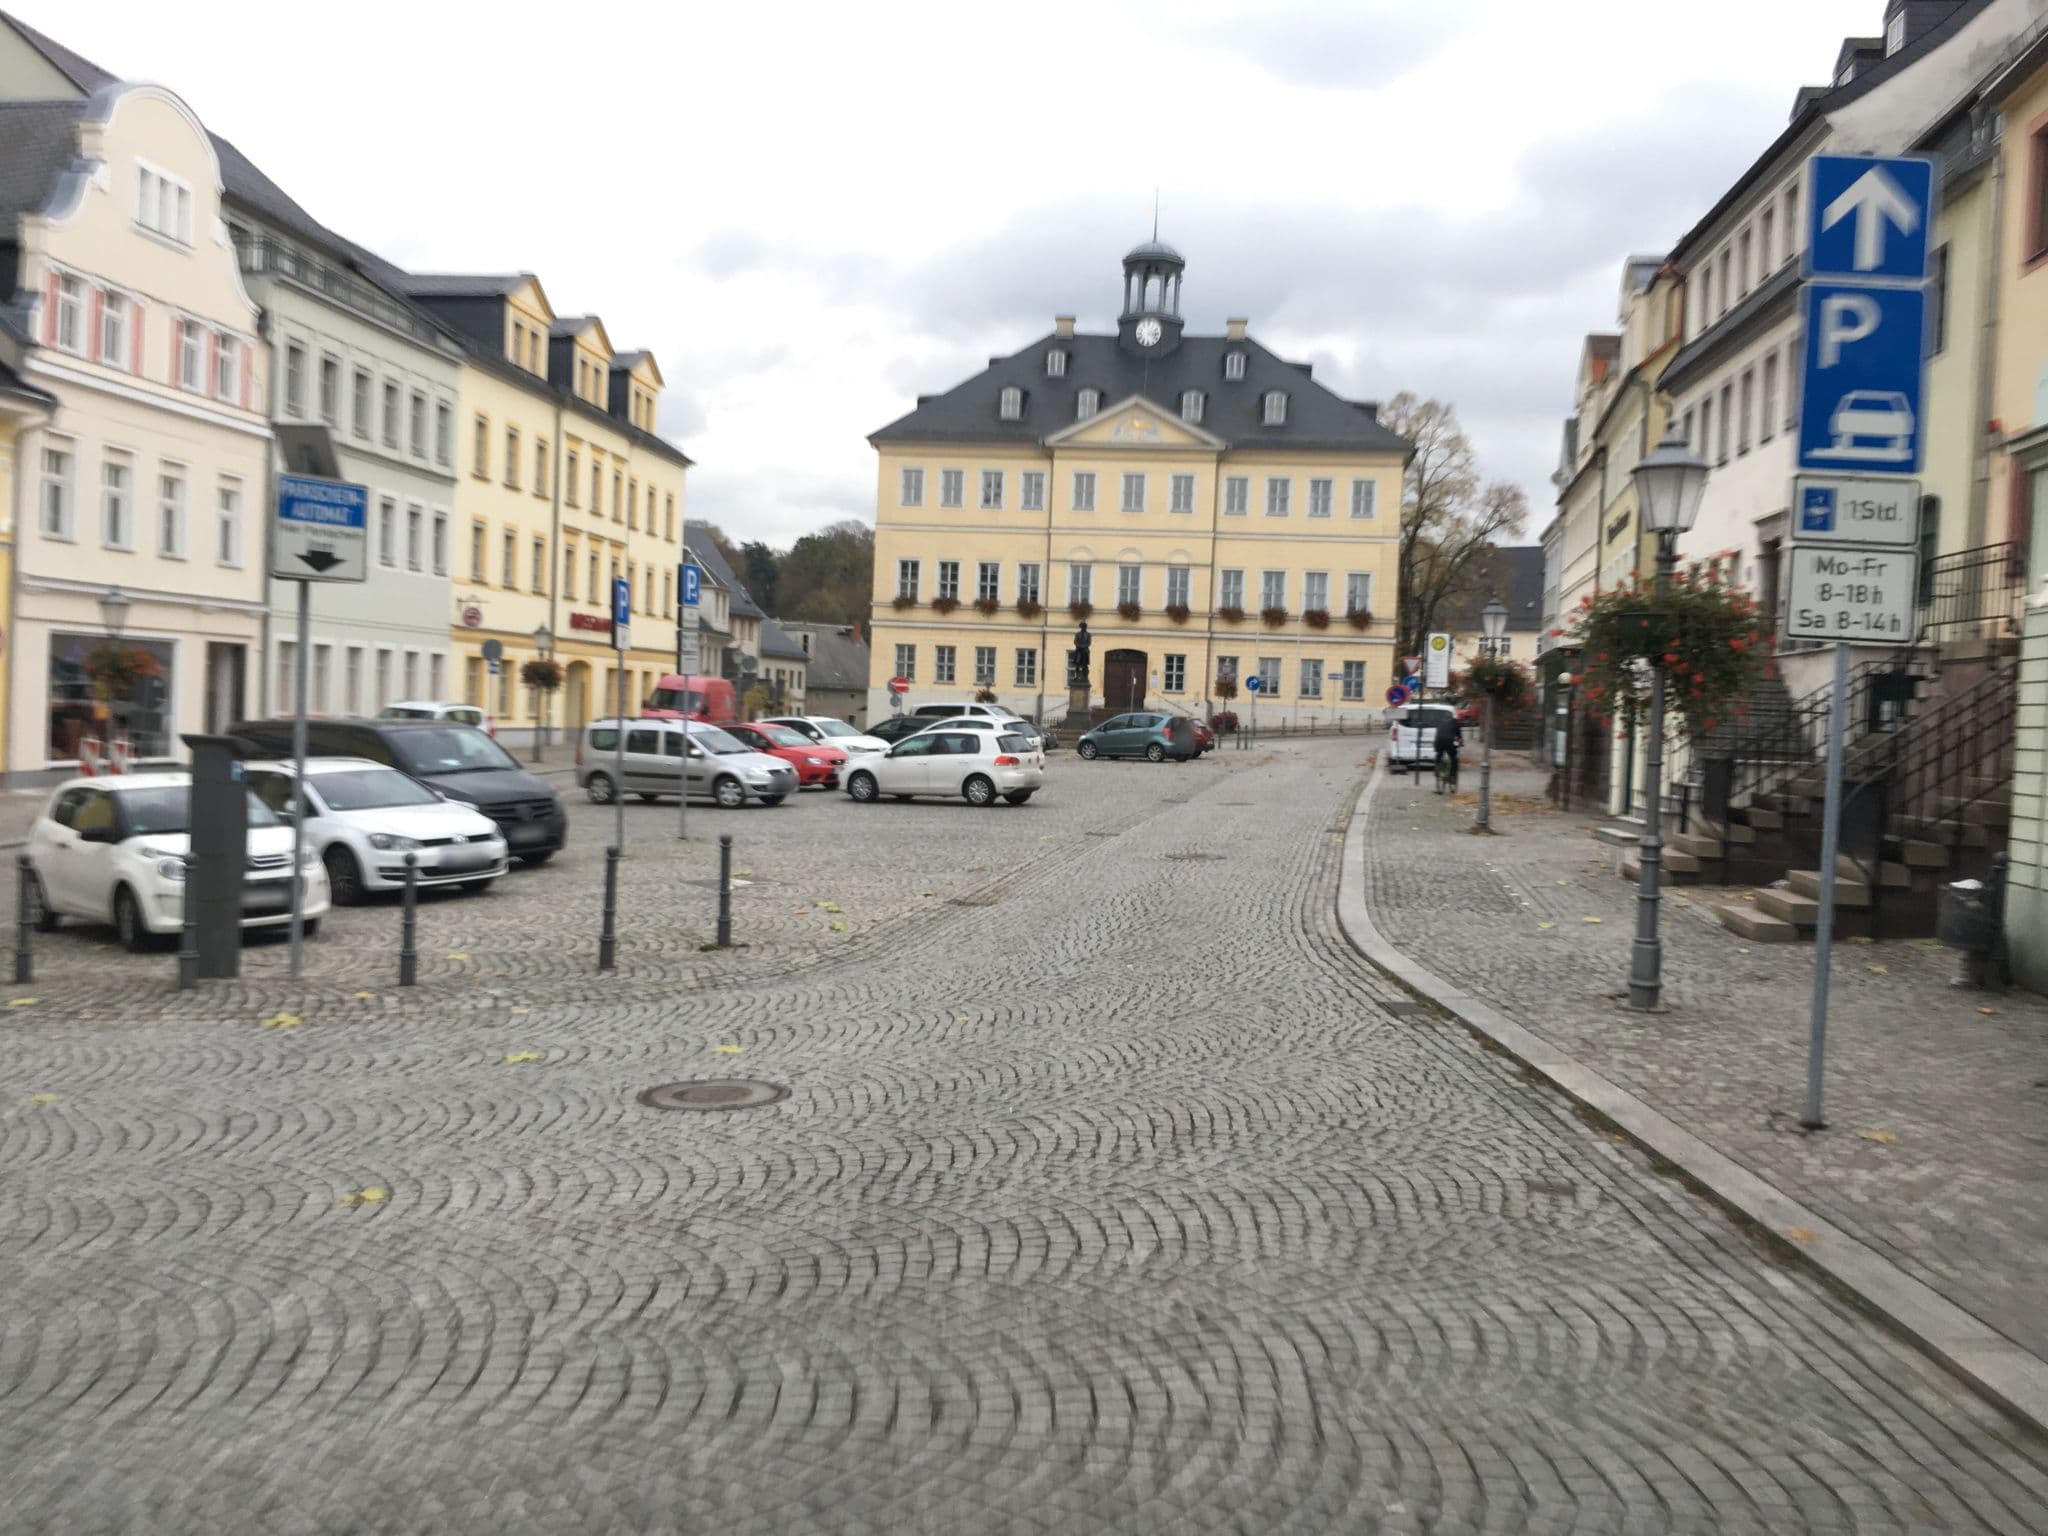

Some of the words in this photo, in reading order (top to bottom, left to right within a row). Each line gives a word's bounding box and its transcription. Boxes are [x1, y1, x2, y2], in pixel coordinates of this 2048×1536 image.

[1817, 293, 1882, 369] P
[292, 501, 354, 525] AUTOMAT
[1814, 555, 1888, 577] Mo-Fr
[1796, 608, 1827, 630] Sa
